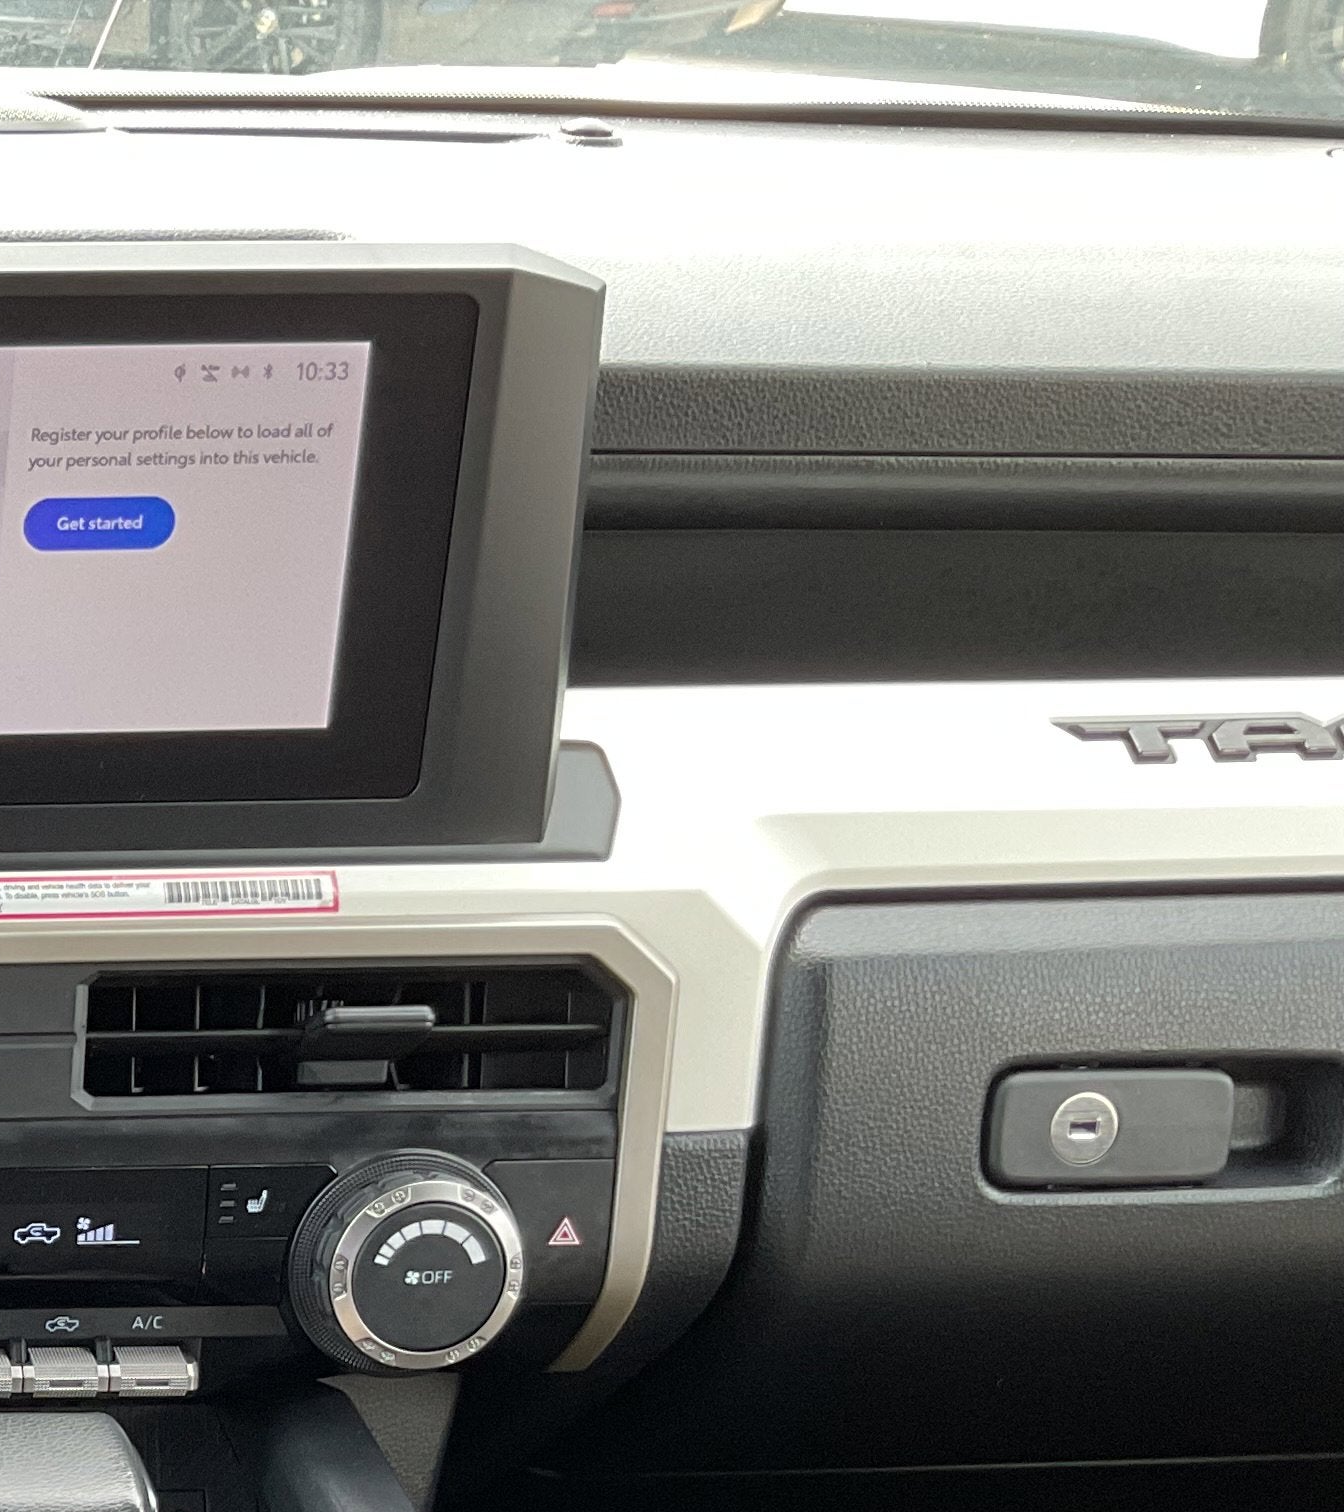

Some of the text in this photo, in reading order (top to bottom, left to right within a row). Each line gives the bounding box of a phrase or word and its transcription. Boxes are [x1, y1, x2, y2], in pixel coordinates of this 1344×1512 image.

[296, 361, 350, 382] 10:33
[30, 422, 334, 445] Register your profile below to load all of
[27, 449, 319, 472] your personal settings into this vehicle.
[56, 513, 145, 532] Get started
[1049, 711, 1344, 764] TA
[420, 1269, 454, 1286] OFF
[130, 1314, 164, 1331] A/C
